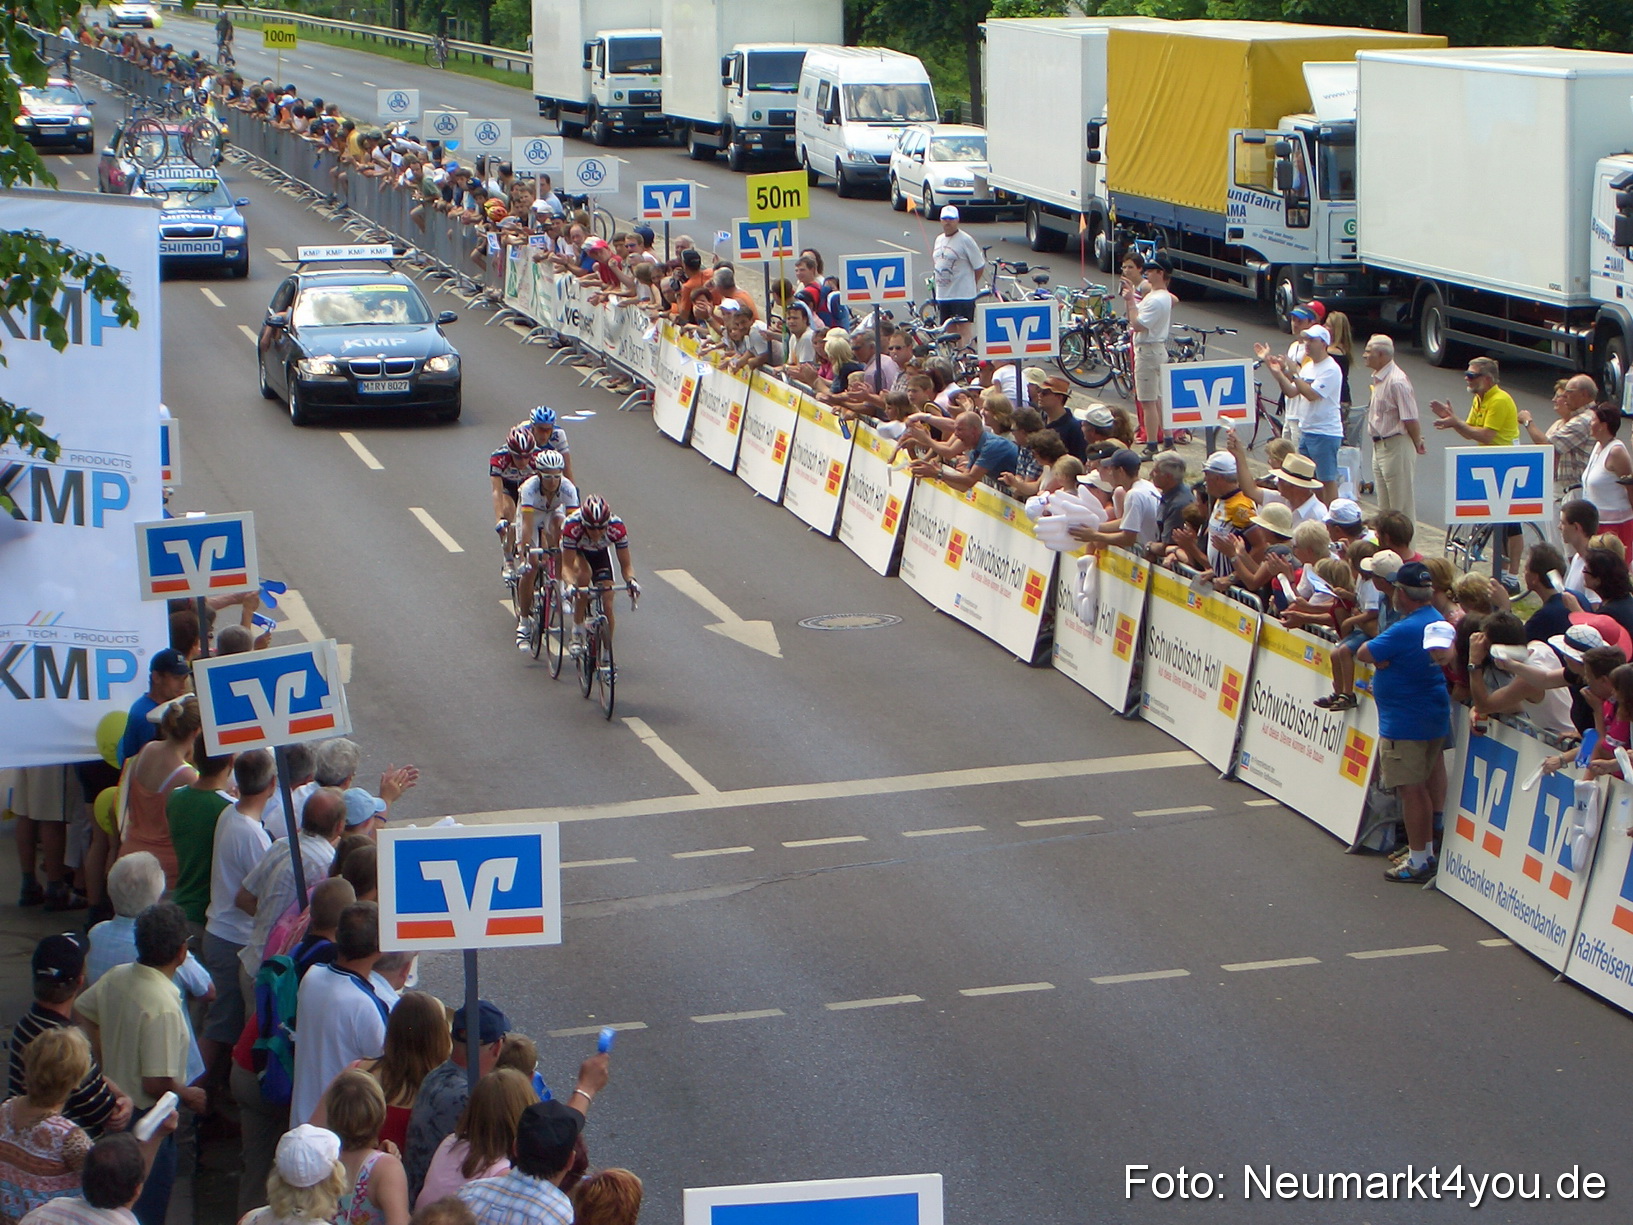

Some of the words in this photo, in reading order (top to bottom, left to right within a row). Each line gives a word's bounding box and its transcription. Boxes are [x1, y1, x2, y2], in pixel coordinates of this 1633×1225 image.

[264, 30, 296, 42] 100m
[145, 168, 214, 179] SHIMANO
[756, 185, 801, 210] 50m
[160, 242, 221, 253] SHIMANO
[344, 338, 407, 348] KMP
[70, 454, 132, 469] PRODUCTS
[965, 535, 1010, 582] Schwäbisch
[1008, 558, 1027, 591] Hall
[27, 629, 58, 639] TECH
[73, 632, 139, 644] PRODUCTS
[1149, 625, 1202, 681] Schwäbisch
[1202, 653, 1222, 691] Hall
[0, 643, 139, 701] KMP
[1251, 679, 1319, 742] Schwäbisch
[1319, 712, 1345, 755] Hall
[1444, 848, 1496, 901] Volksbanken
[1495, 881, 1567, 948] Raiffeisenbanken
